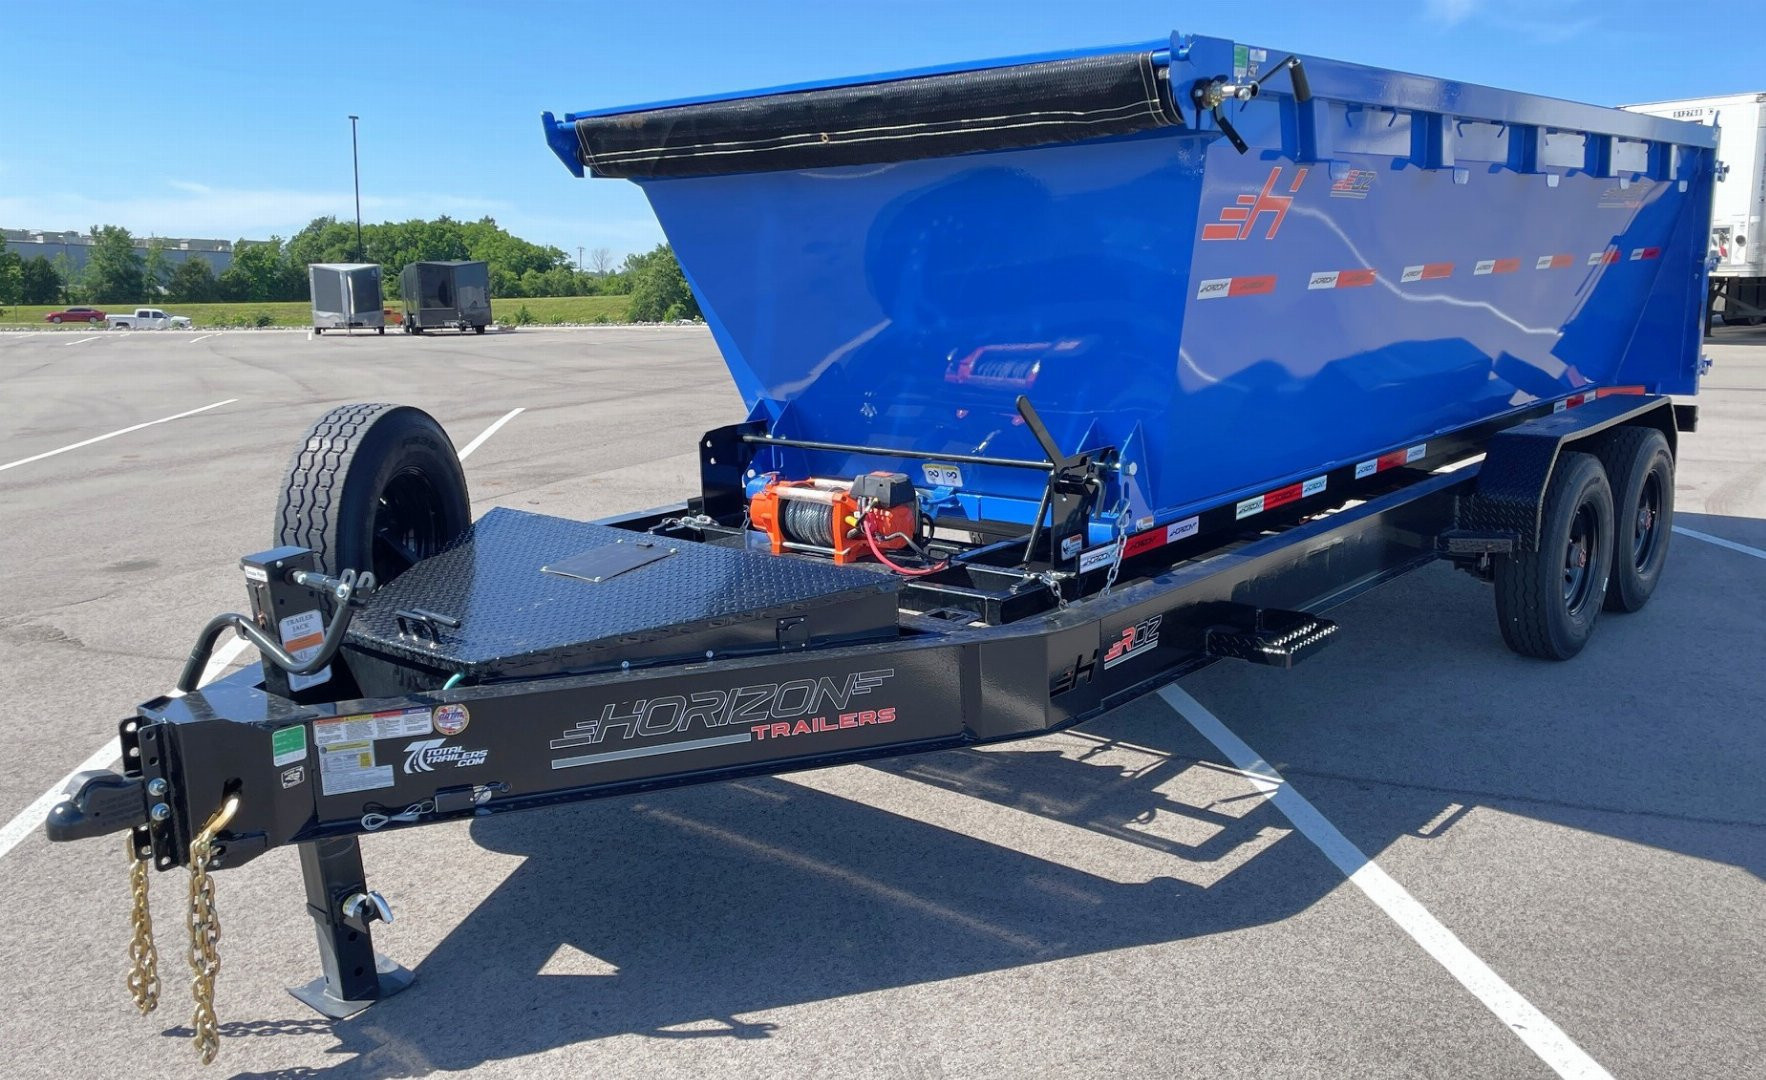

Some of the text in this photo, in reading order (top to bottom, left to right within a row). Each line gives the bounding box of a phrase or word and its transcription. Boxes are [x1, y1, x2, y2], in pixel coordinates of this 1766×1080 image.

[286, 613, 314, 626] TRAILER
[292, 623, 310, 632] JACK
[592, 672, 859, 744] HORIZON
[751, 707, 896, 741] TRAILERS
[426, 746, 465, 757] TOTAL
[426, 750, 489, 764] TRAILERS
[454, 757, 486, 768] .COM
